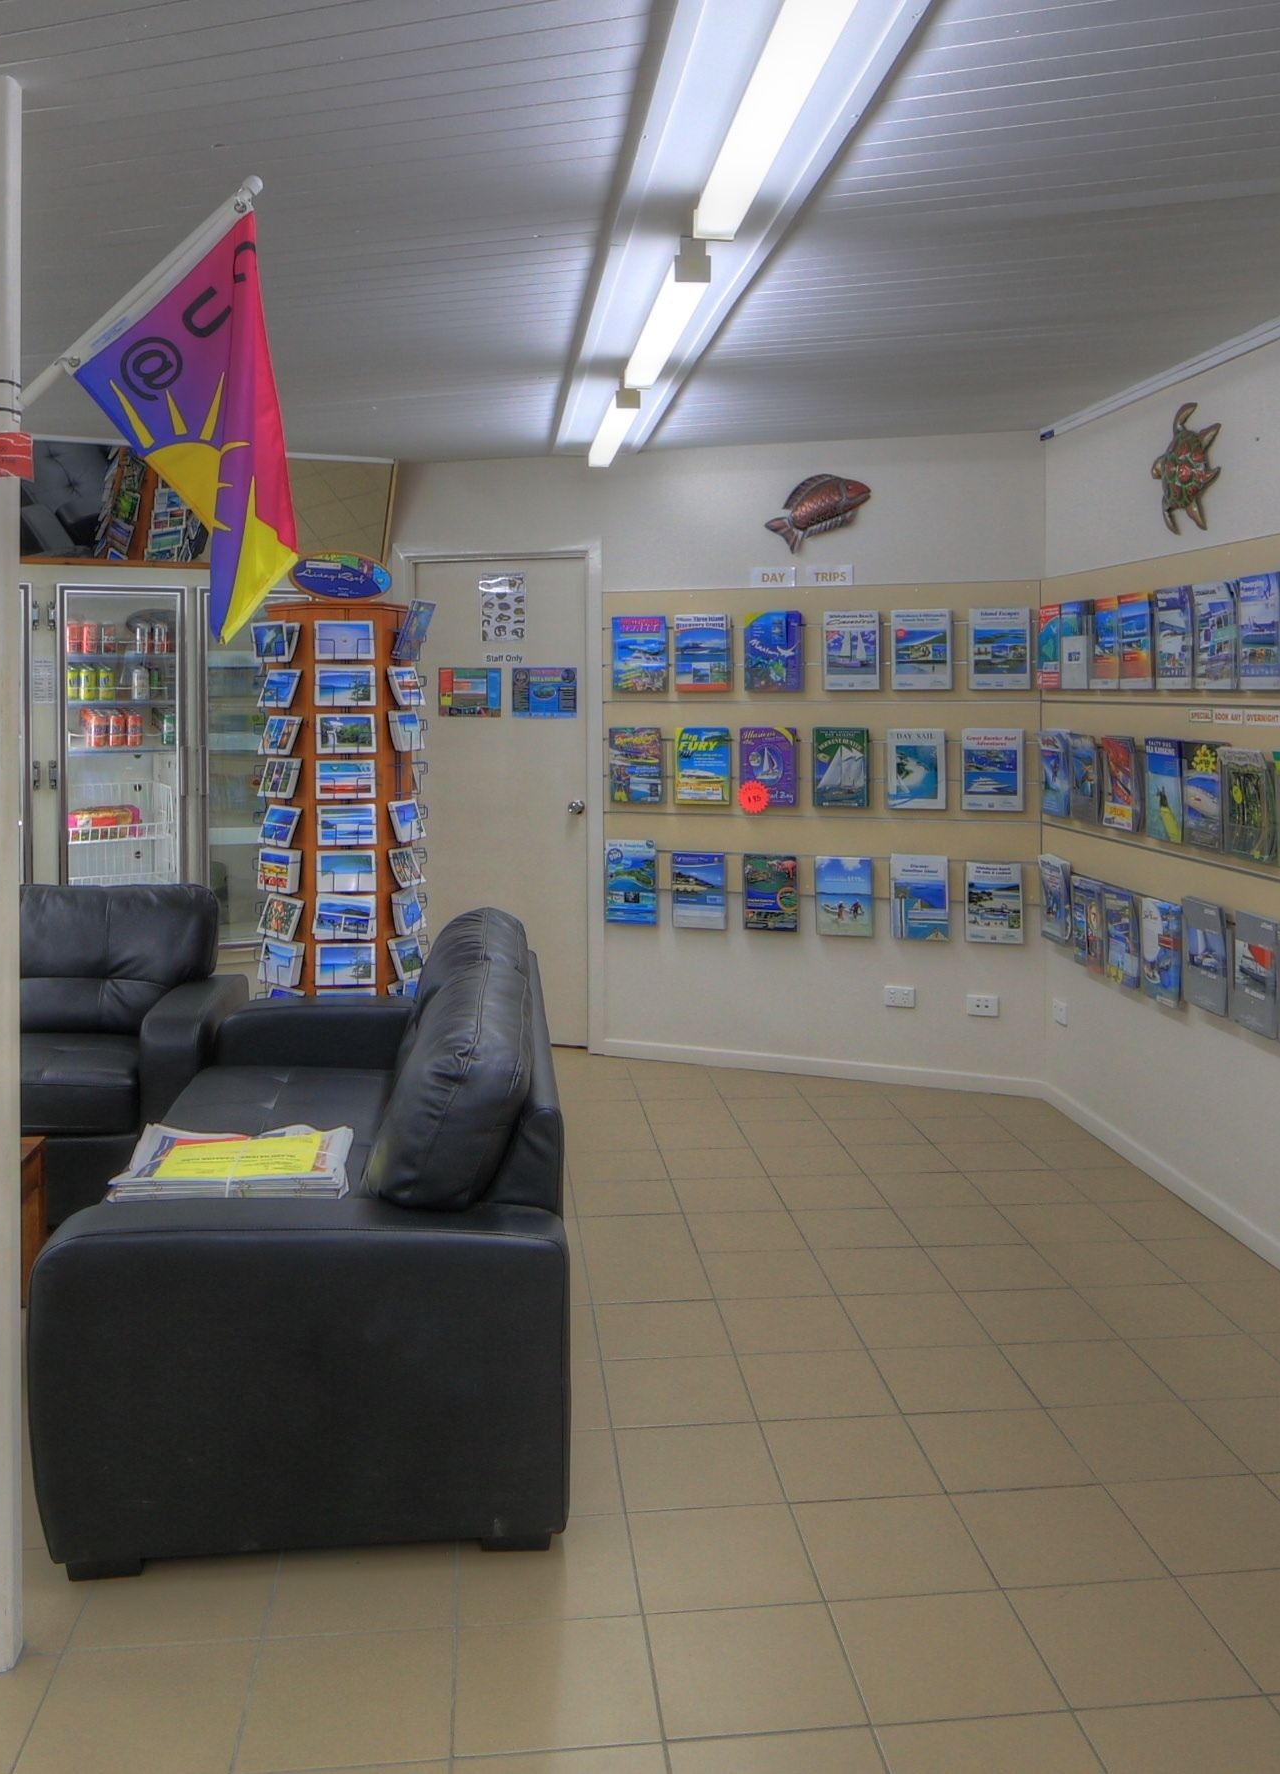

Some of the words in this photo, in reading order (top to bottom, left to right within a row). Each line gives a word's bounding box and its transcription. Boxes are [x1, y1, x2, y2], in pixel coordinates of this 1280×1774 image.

[120, 336, 183, 401] @
[761, 573, 786, 583] DAY
[814, 571, 846, 582] TRIPS
[486, 654, 504, 663] Staff
[505, 654, 523, 664] Only
[1246, 714, 1279, 723] OVERNIGHT
[896, 732, 912, 740] DAY
[916, 732, 934, 740] SAIL
[678, 741, 718, 751] FURY
